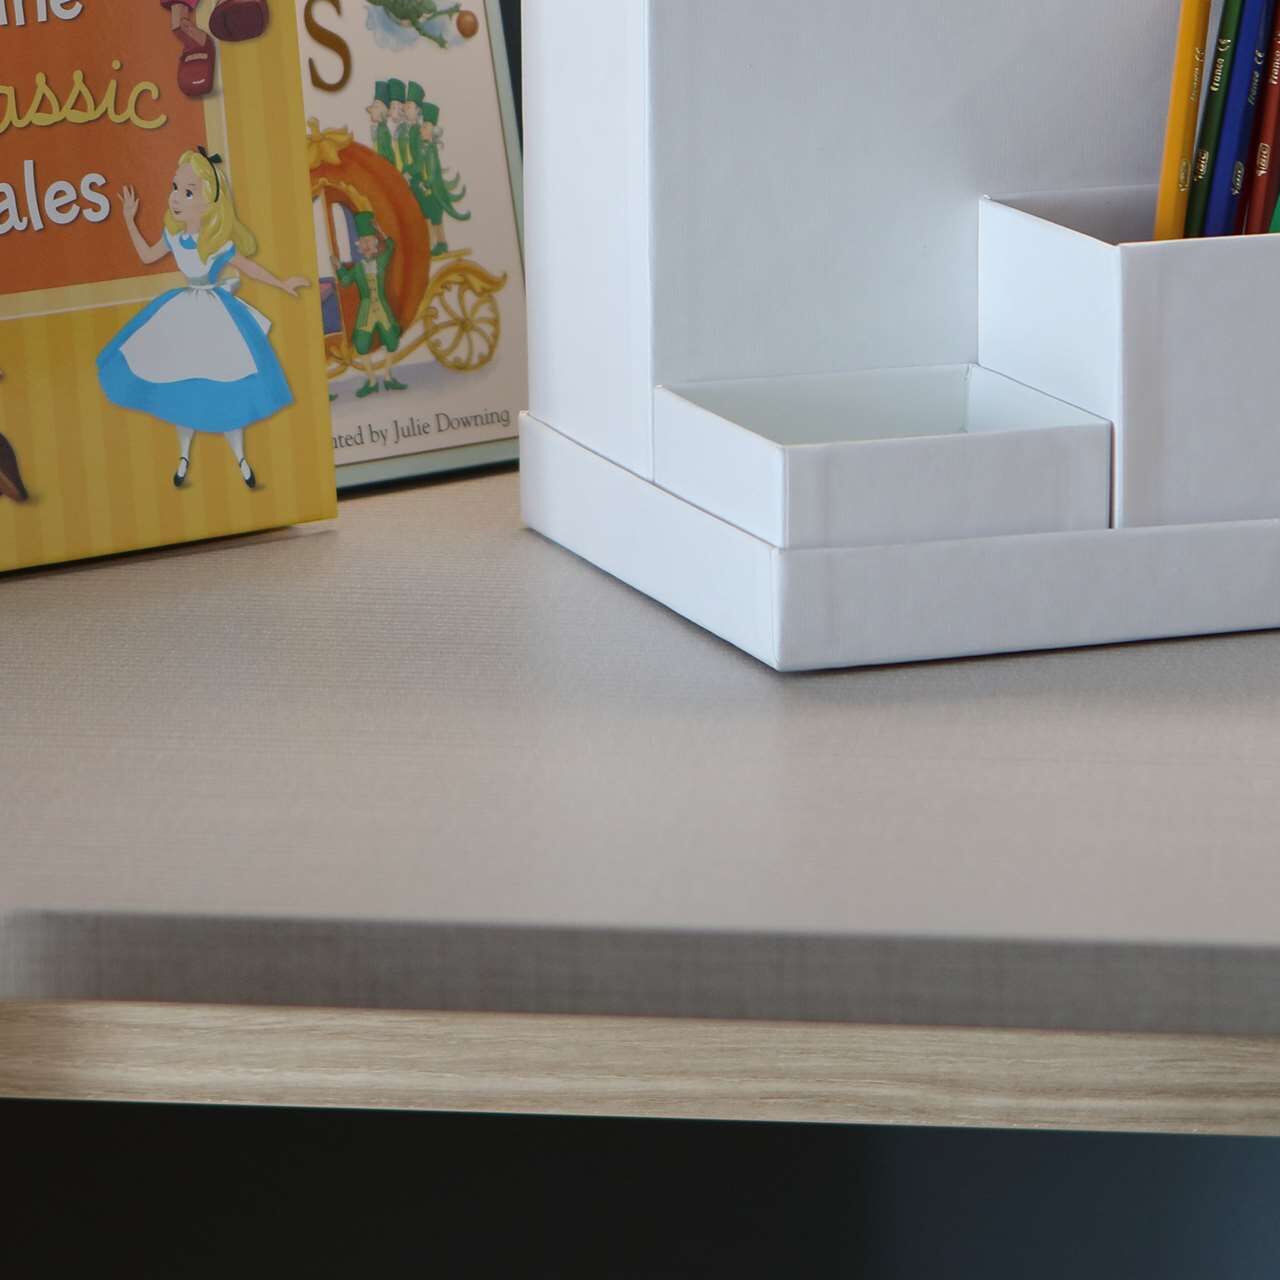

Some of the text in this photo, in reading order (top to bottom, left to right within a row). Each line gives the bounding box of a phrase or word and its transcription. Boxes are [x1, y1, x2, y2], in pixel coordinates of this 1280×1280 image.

[369, 423, 388, 446] by
[393, 419, 431, 444] Julie
[435, 407, 511, 434] Downing
